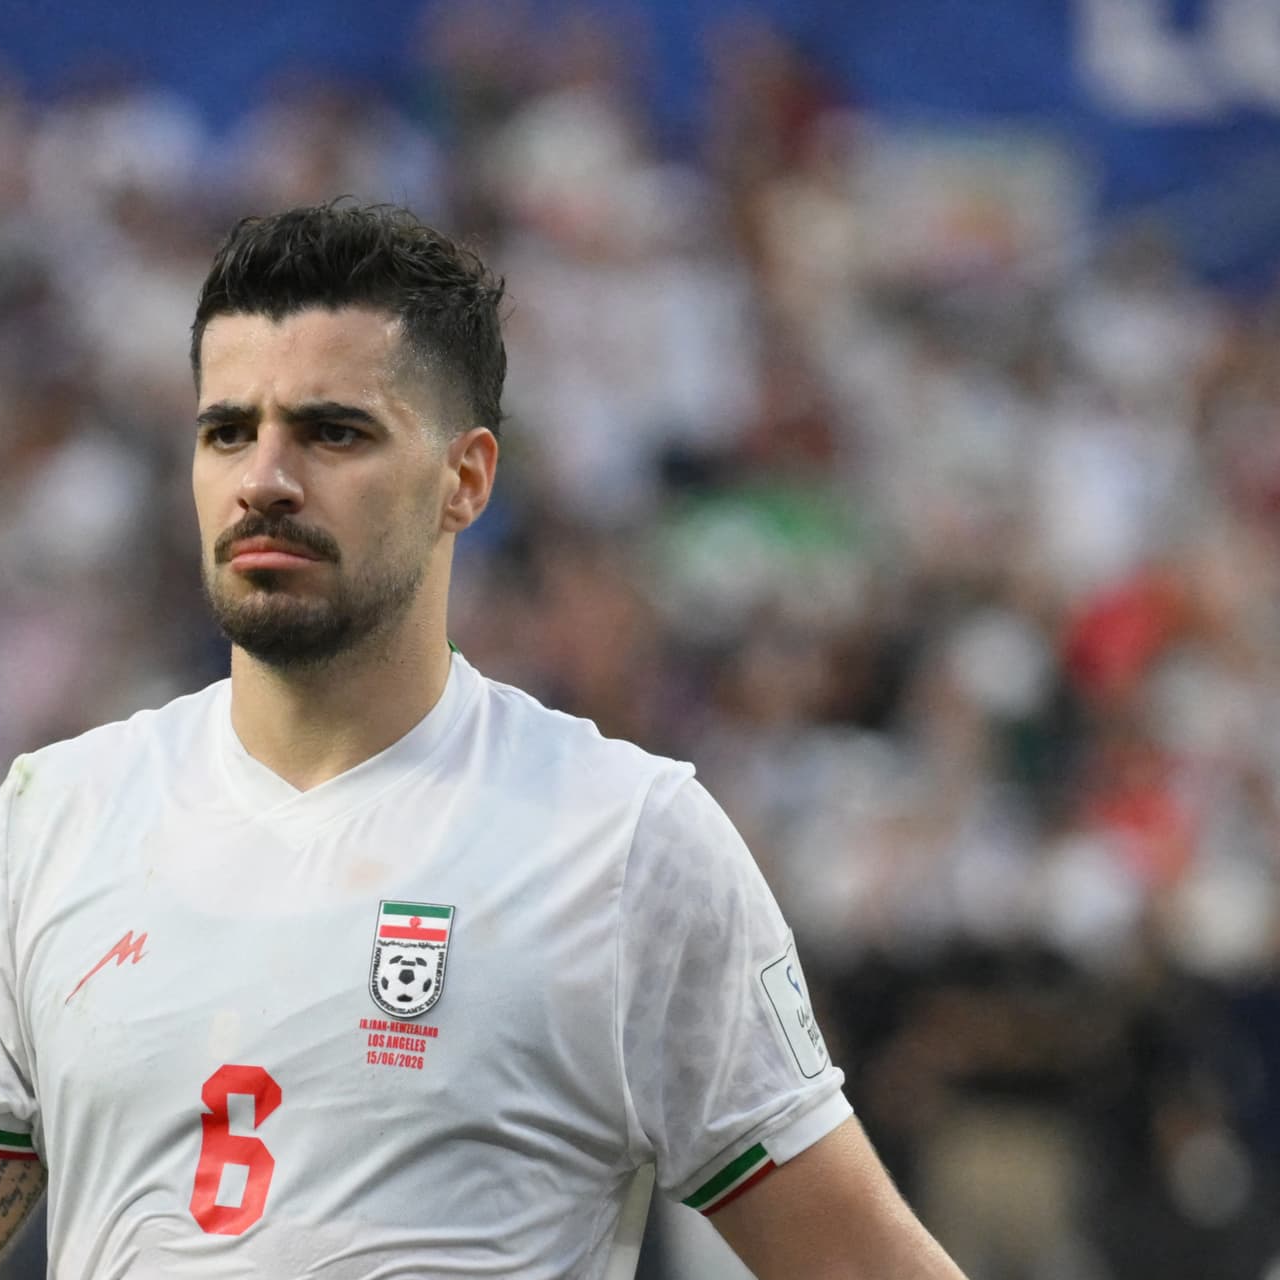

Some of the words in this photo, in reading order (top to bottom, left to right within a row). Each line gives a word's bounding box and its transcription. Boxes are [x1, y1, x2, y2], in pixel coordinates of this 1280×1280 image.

[368, 1034, 385, 1048] LOS
[386, 1036, 426, 1053] ANGELES
[367, 1051, 424, 1070] 15/06/2026
[189, 1064, 282, 1236] 6
